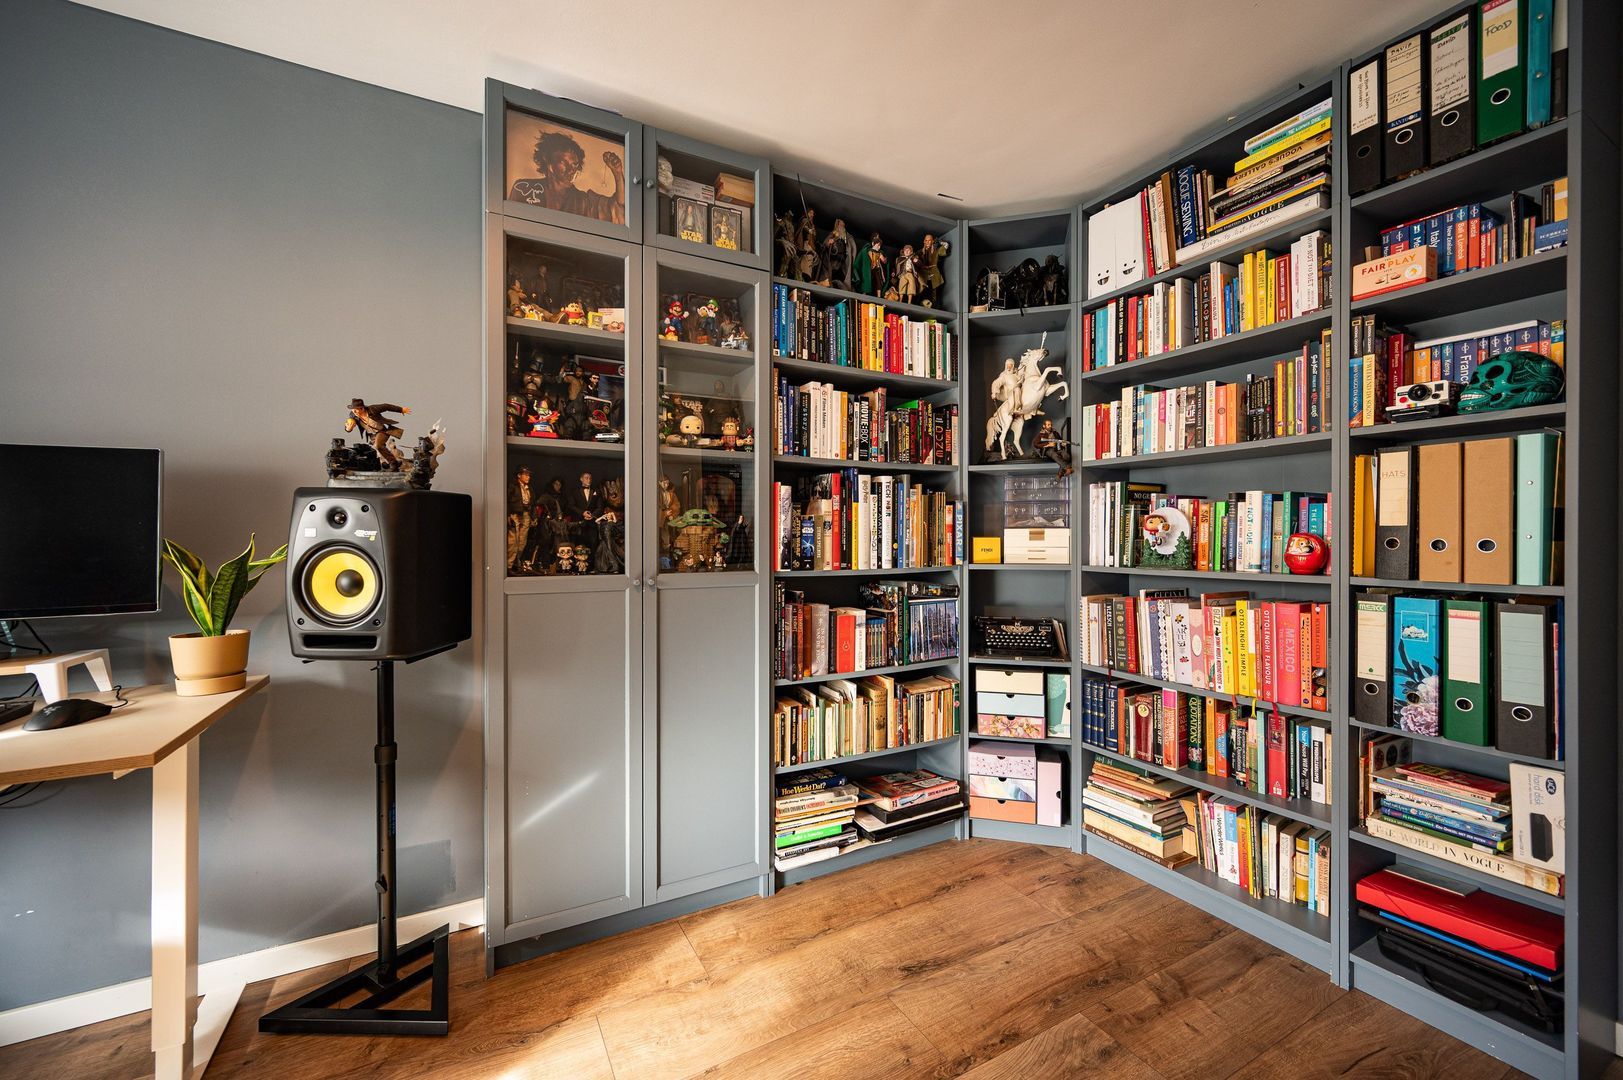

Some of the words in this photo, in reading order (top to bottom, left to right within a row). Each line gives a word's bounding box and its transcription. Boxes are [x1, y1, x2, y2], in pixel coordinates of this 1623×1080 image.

[1484, 19, 1513, 37] FOOD
[1268, 146, 1302, 165] VOGUE'S
[1233, 163, 1267, 182] GALLERY
[1177, 168, 1190, 204] VOGUE
[1180, 200, 1193, 237] SEWING
[1247, 200, 1285, 222] VOGUE
[1430, 230, 1440, 248] Italy
[1470, 220, 1478, 238] Svezia
[1361, 262, 1386, 276] FAIR
[1387, 254, 1416, 269] PLAY
[1444, 359, 1452, 376] Kenya
[860, 400, 869, 444] MOVIE:BOX
[1286, 628, 1295, 673] MEXICO
[1189, 697, 1198, 743] QUOTATIONS
[781, 786, 794, 795] Hoe
[794, 784, 812, 794] Werkt
[812, 782, 826, 790] Dat?
[1374, 824, 1394, 838] THE
[1400, 832, 1438, 851] WORLD
[1444, 846, 1457, 858] IN
[1462, 852, 1504, 873] VOGUE
